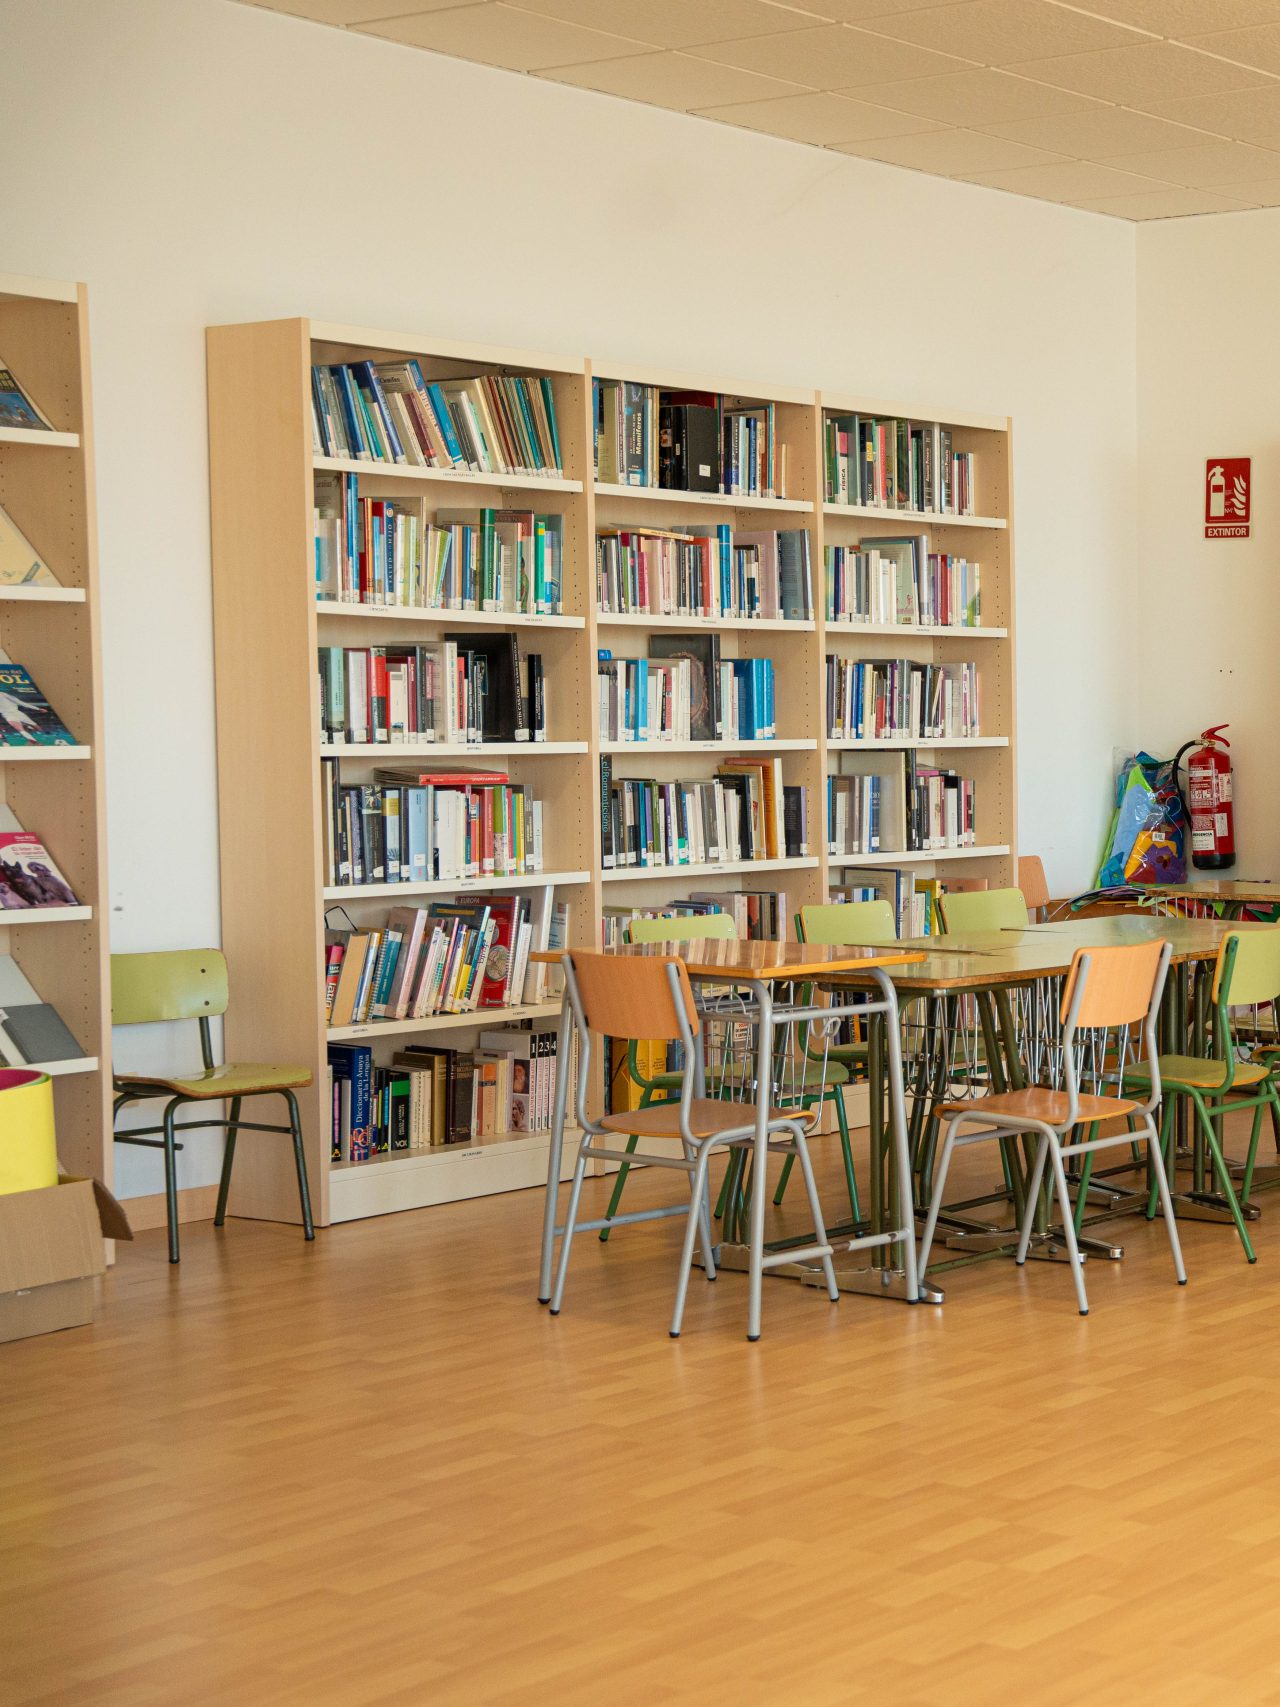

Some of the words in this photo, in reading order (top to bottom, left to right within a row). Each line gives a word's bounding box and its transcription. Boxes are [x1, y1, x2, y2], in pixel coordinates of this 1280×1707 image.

[1207, 528, 1247, 537] EXTINTOR
[601, 772, 609, 833] Romanticismo
[532, 1043, 536, 1053] 1
[538, 1042, 544, 1053] 2
[544, 1041, 549, 1052] 3
[550, 1041, 557, 1051] 4
[355, 1054, 363, 1077] Anaya
[362, 1054, 370, 1082] Lengua
[355, 1079, 363, 1122] Diccionario
[363, 1093, 368, 1101] de
